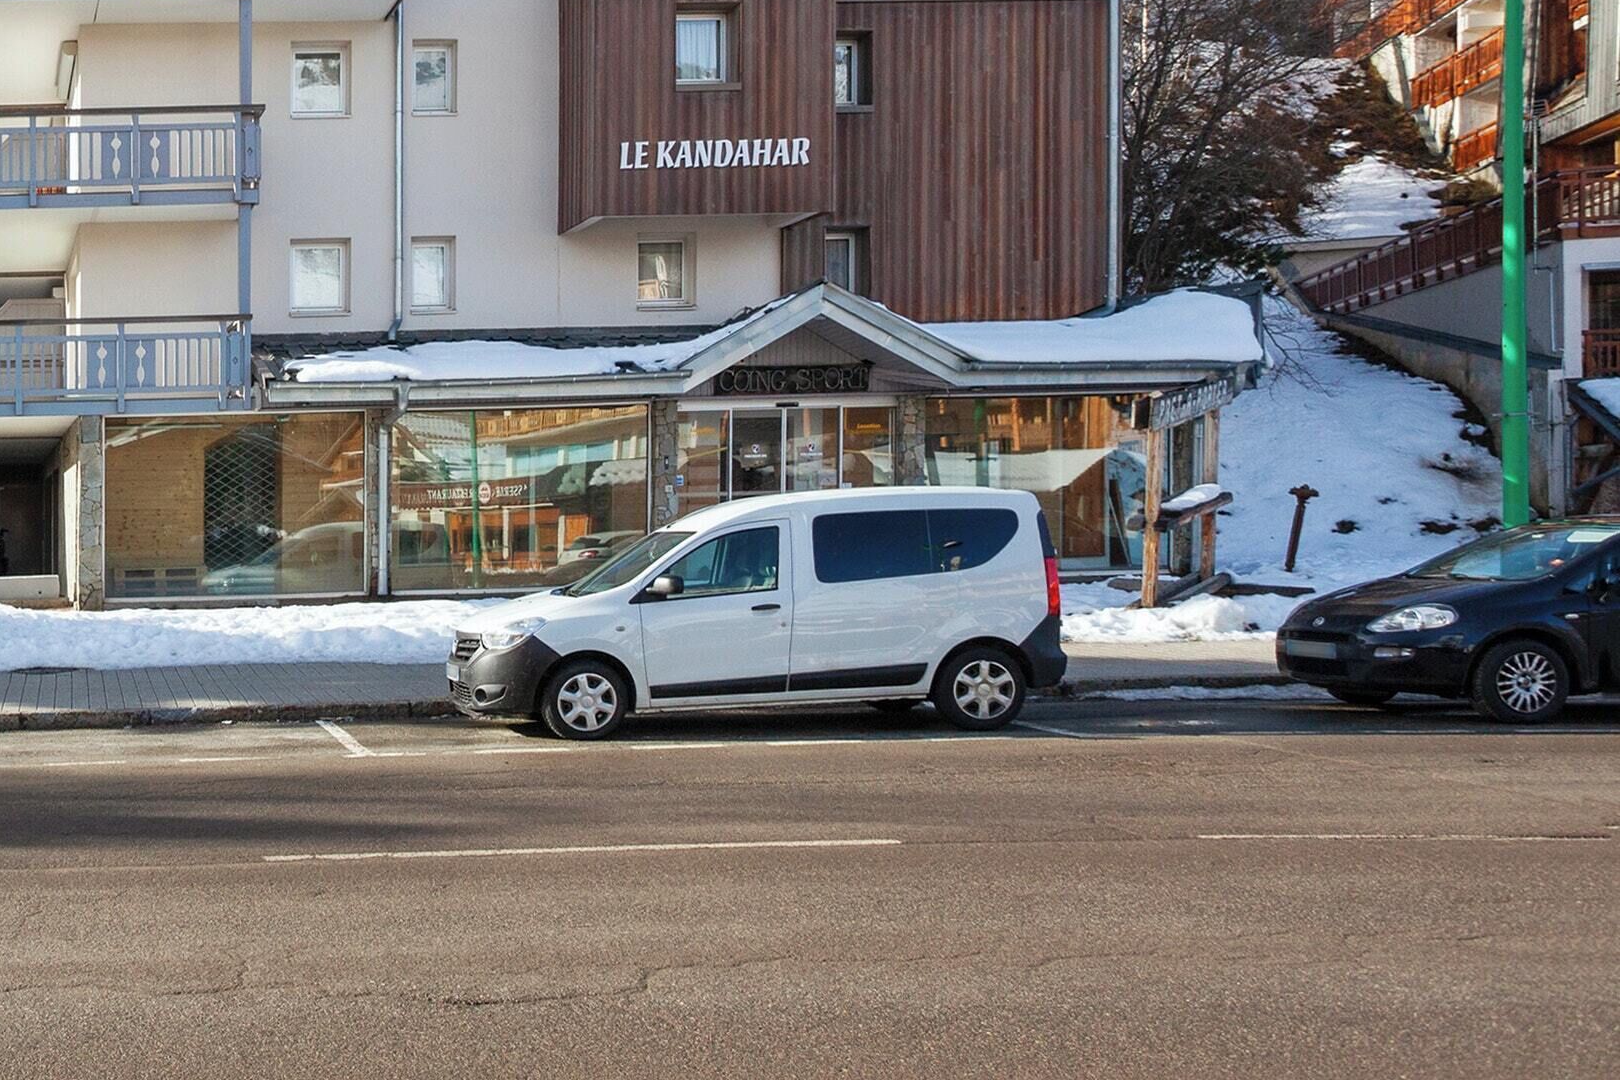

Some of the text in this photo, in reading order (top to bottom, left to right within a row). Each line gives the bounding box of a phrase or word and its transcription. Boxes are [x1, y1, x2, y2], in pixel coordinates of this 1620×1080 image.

[619, 137, 811, 170] LE KANDAHAR
[719, 366, 869, 393] COING SPORT
